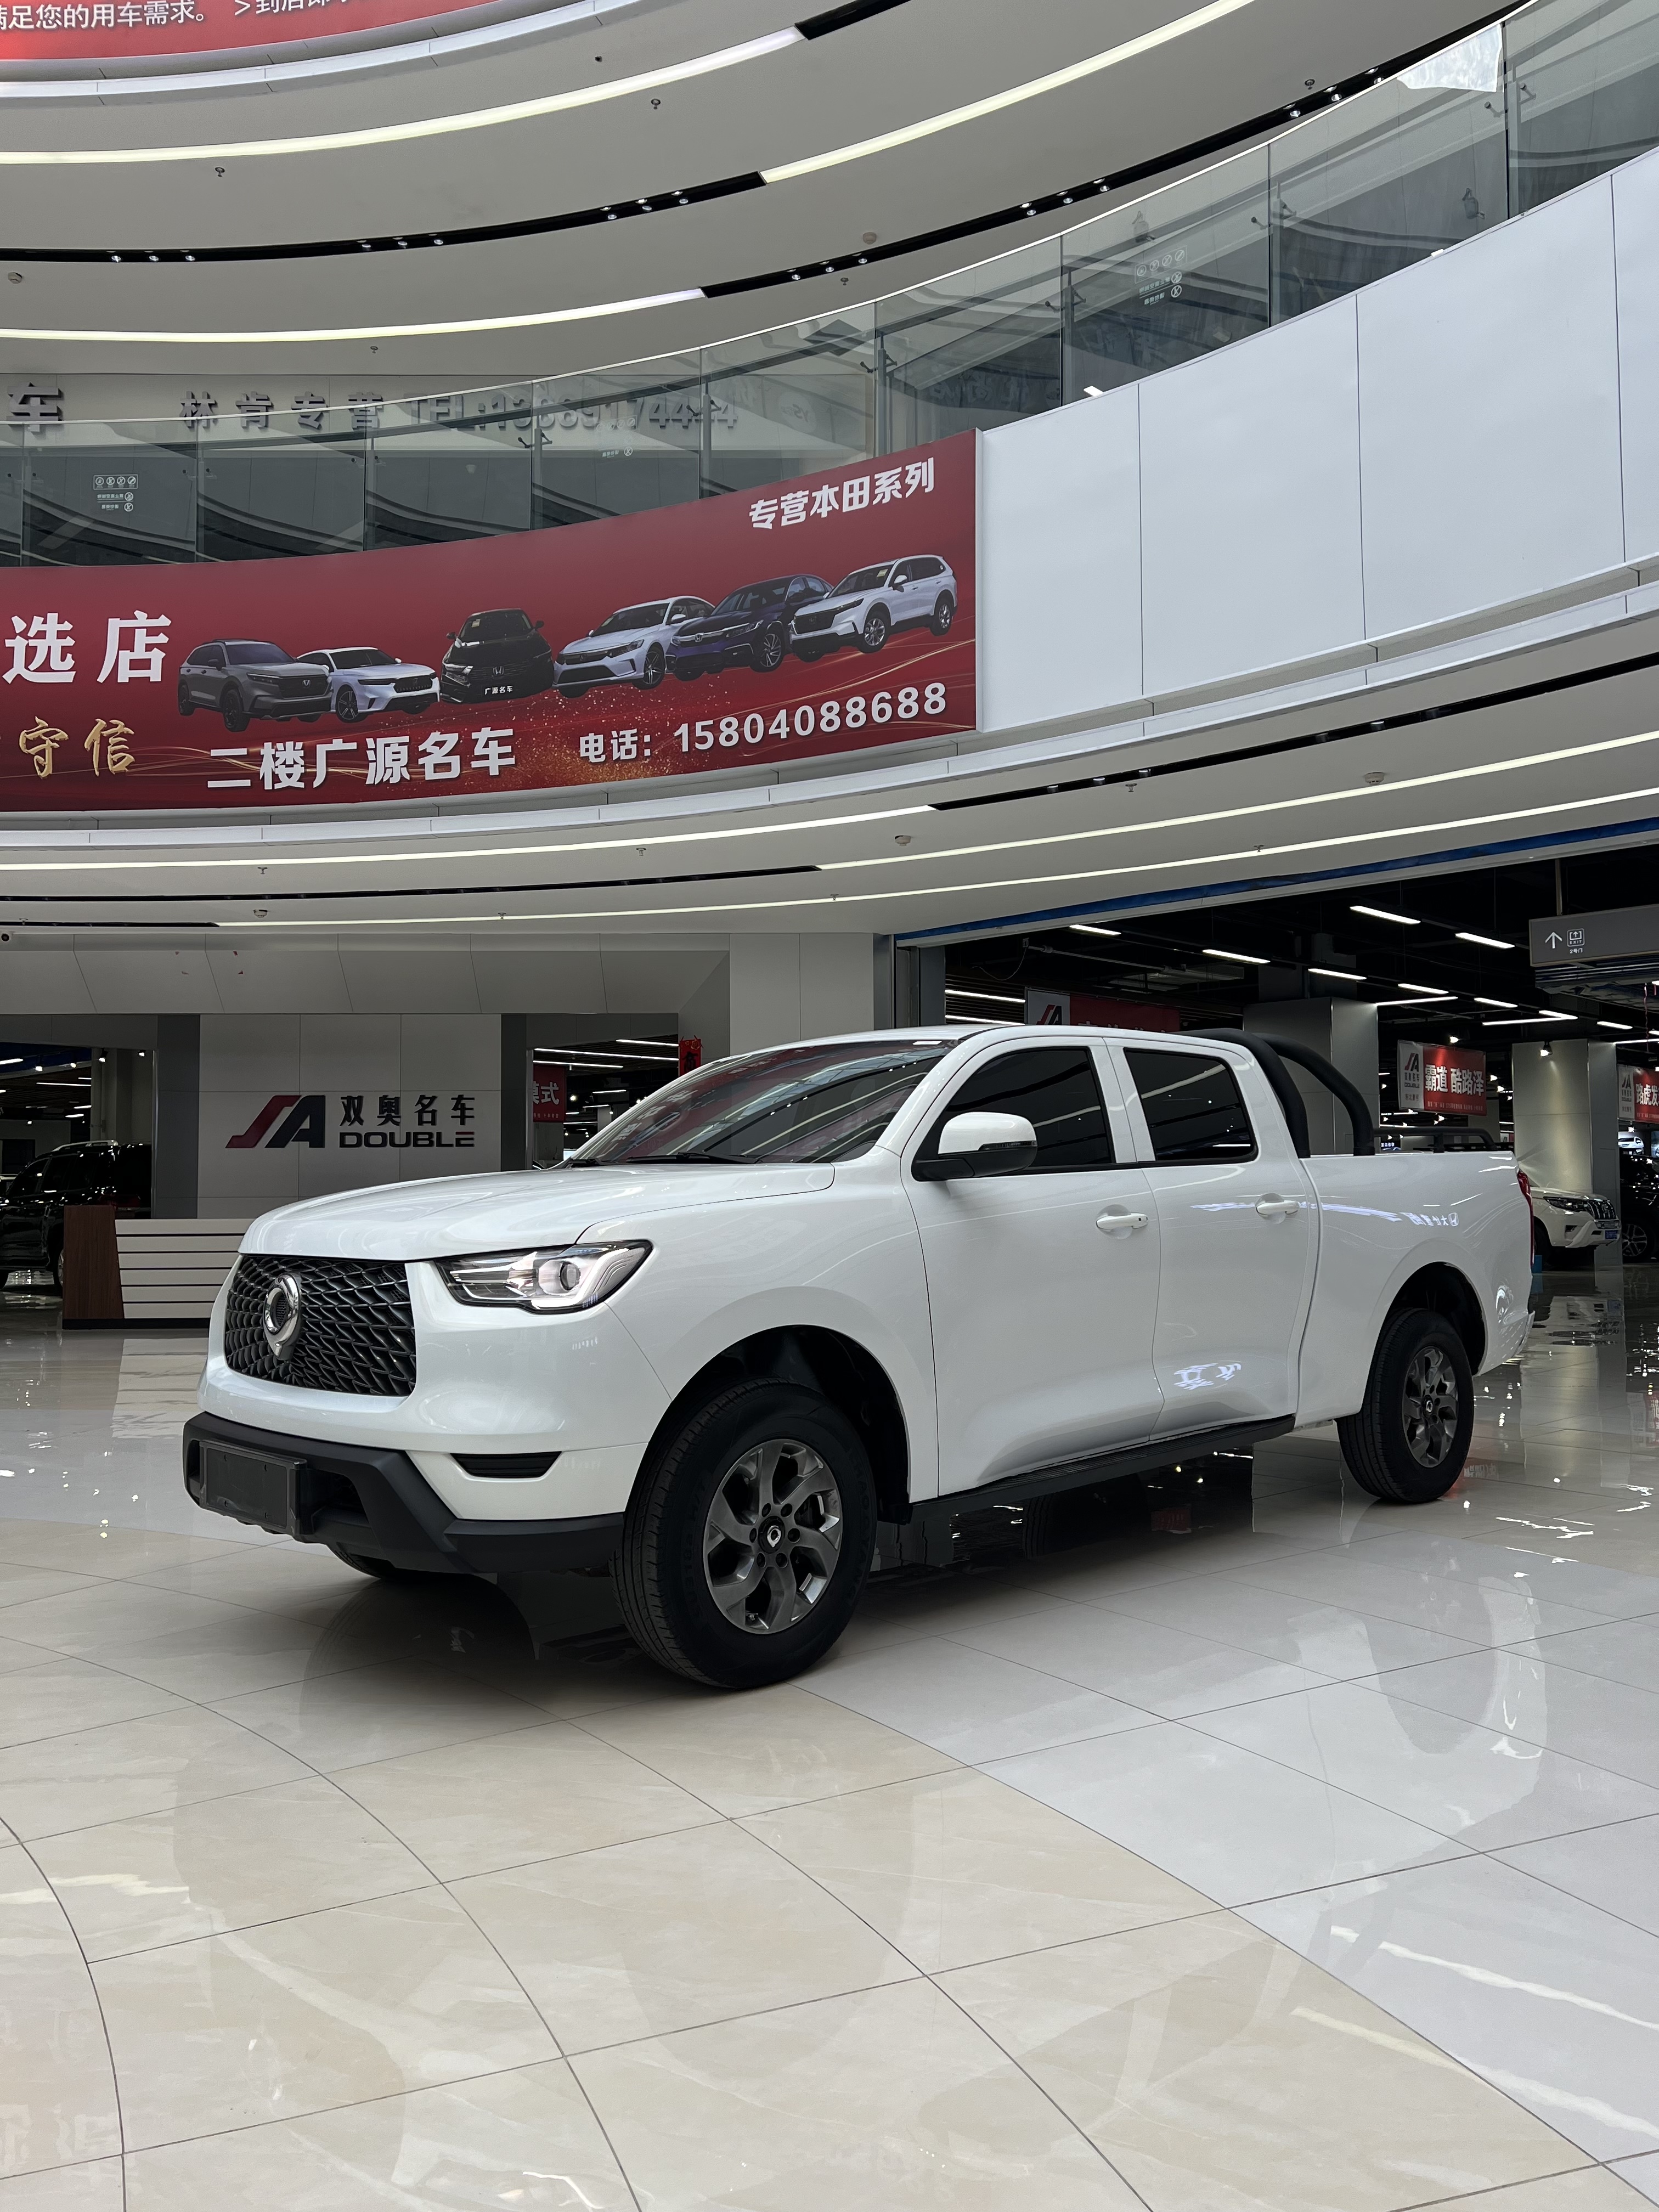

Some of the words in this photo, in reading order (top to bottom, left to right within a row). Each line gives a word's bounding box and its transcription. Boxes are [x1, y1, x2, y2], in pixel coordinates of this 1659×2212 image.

[749, 457, 934, 529] 专营本田系列
[484, 685, 513, 695] 广源名车
[673, 682, 947, 752] 15804088688
[207, 727, 516, 790] 二楼广源名车
[1425, 1064, 1448, 1092] 霸道
[1450, 1068, 1485, 1096] 酷路泽
[340, 1094, 476, 1126] 双奥名车
[339, 1131, 475, 1148] DOUBLE
